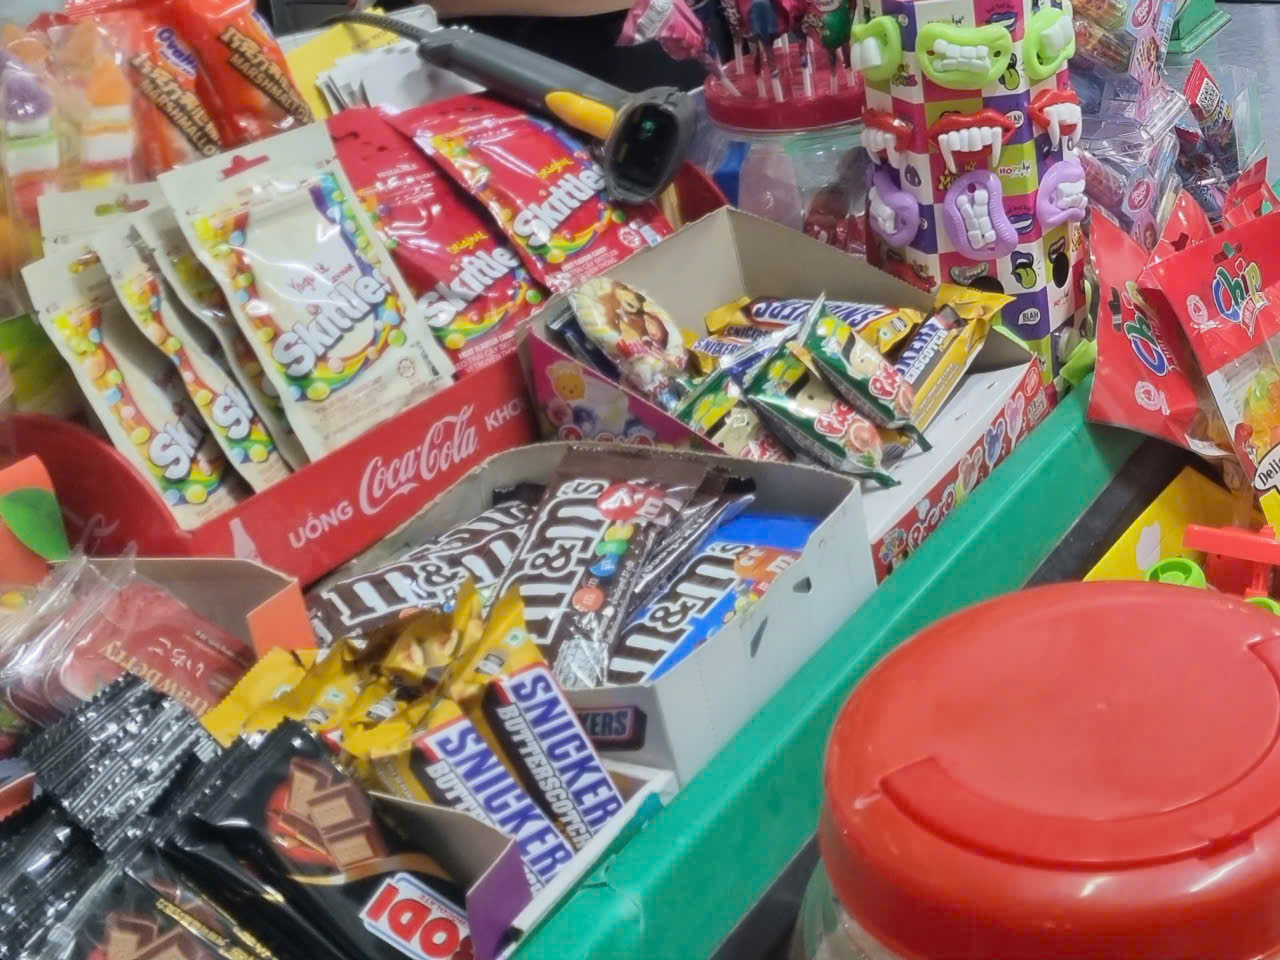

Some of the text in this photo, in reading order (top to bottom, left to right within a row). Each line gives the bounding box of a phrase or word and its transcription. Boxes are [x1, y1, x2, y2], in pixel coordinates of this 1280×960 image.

[1022, 311, 1039, 321] BLAH
[288, 500, 353, 549] UỐNG
[358, 404, 479, 516] Coca-Cola
[98, 640, 211, 720] trawberry
[147, 637, 206, 680] いちご
